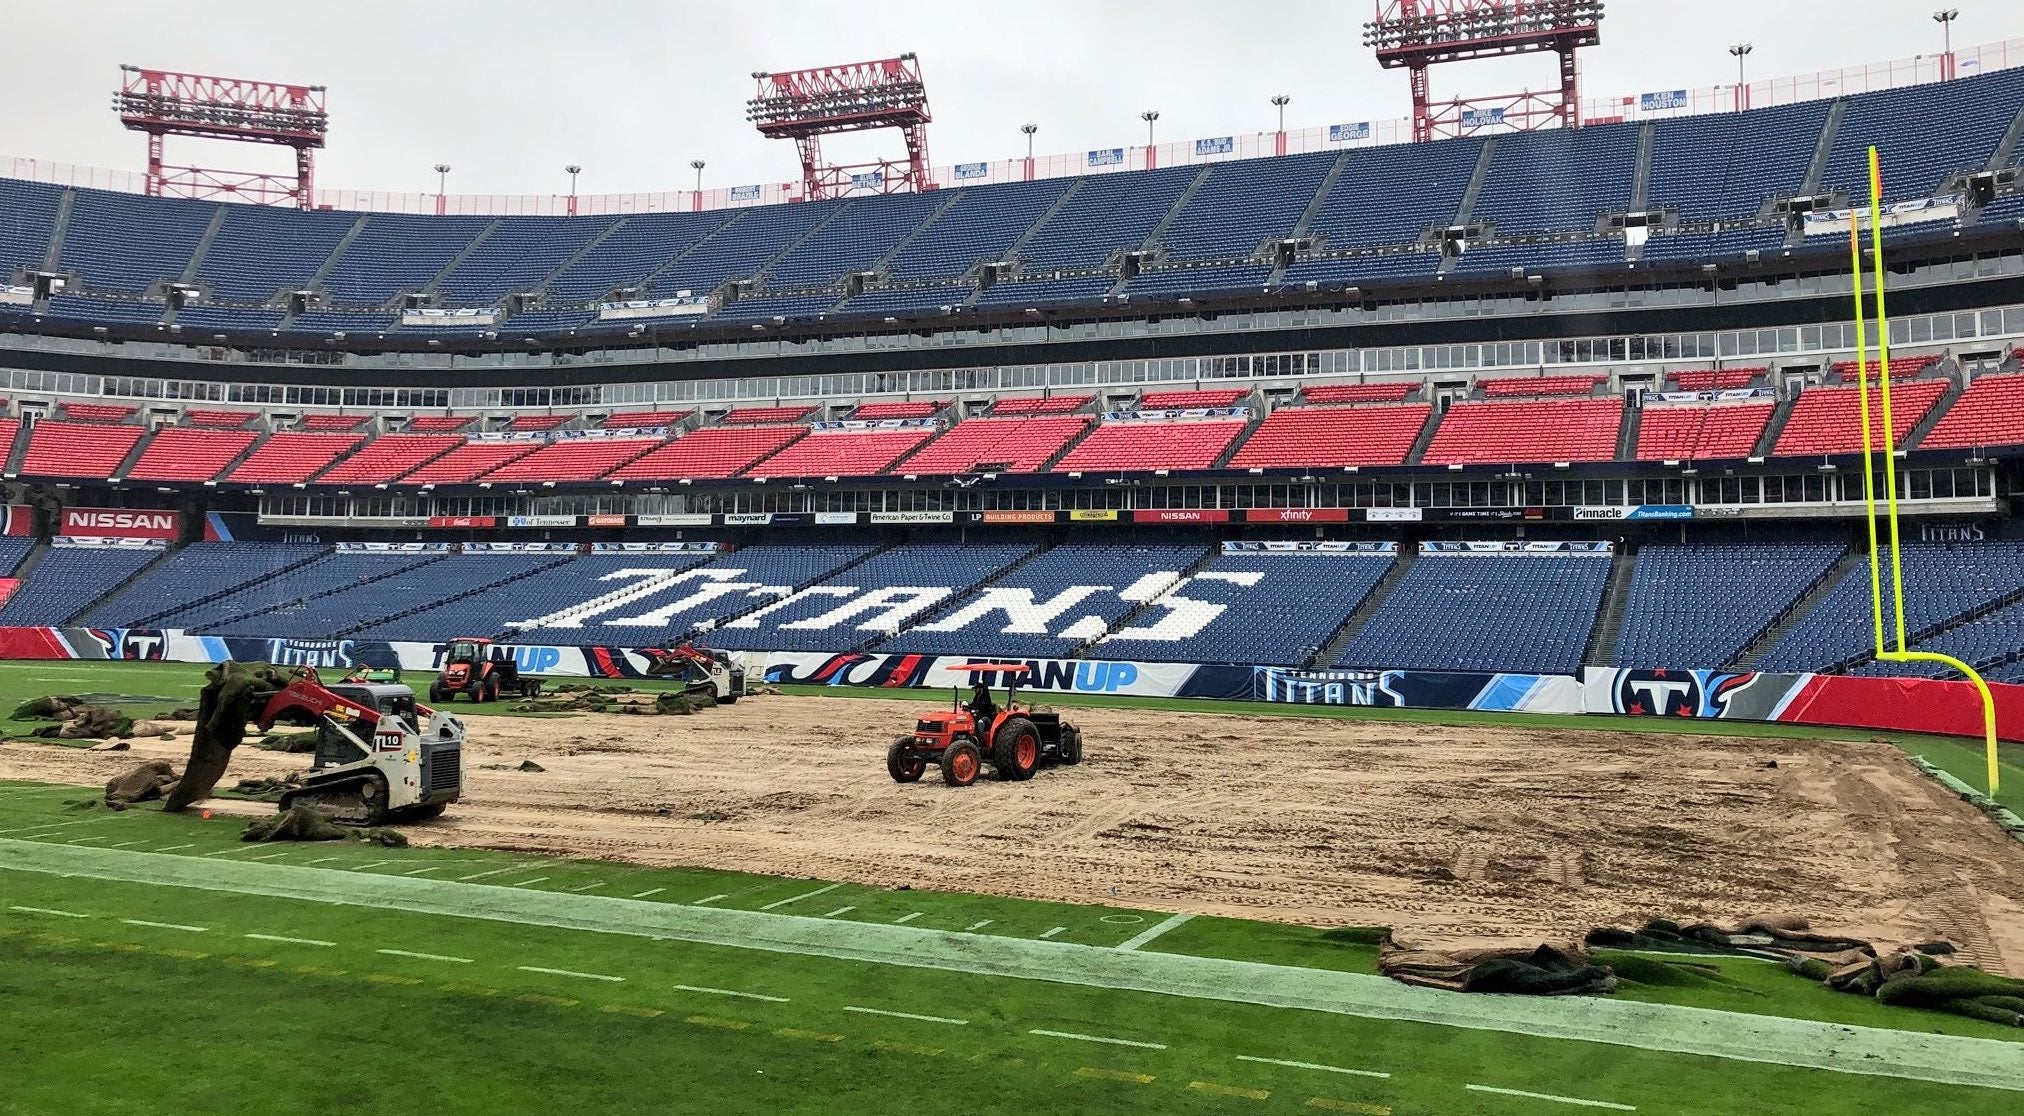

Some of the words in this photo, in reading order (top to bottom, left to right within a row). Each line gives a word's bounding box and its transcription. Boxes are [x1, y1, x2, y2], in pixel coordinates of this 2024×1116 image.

[1654, 92, 1674, 100] KEN
[1642, 98, 1686, 110] HOUSTON
[1463, 115, 1503, 126] HOLOVAK
[1340, 123, 1360, 132] EDDIE
[1330, 129, 1369, 140] GEORGE
[1197, 145, 1221, 154] ADAMS
[1089, 155, 1123, 166] CAMPBELL
[956, 168, 987, 179] BLANDA
[728, 513, 766, 523] maynard
[901, 513, 919, 521] Paper
[971, 513, 982, 521] LP
[985, 512, 1016, 520] BUILDING
[1018, 512, 1053, 520] PRODUCTS
[1161, 512, 1200, 520] NISSAN
[1280, 510, 1313, 520] xfinity
[1575, 508, 1622, 519] Pinnacle
[69, 512, 173, 530] NISSAN
[536, 518, 571, 526] Tennessee
[1921, 523, 1984, 541] TITANS
[504, 568, 1264, 643] TITANS
[267, 638, 355, 669] TITANS
[1254, 665, 1405, 707] TITANS
